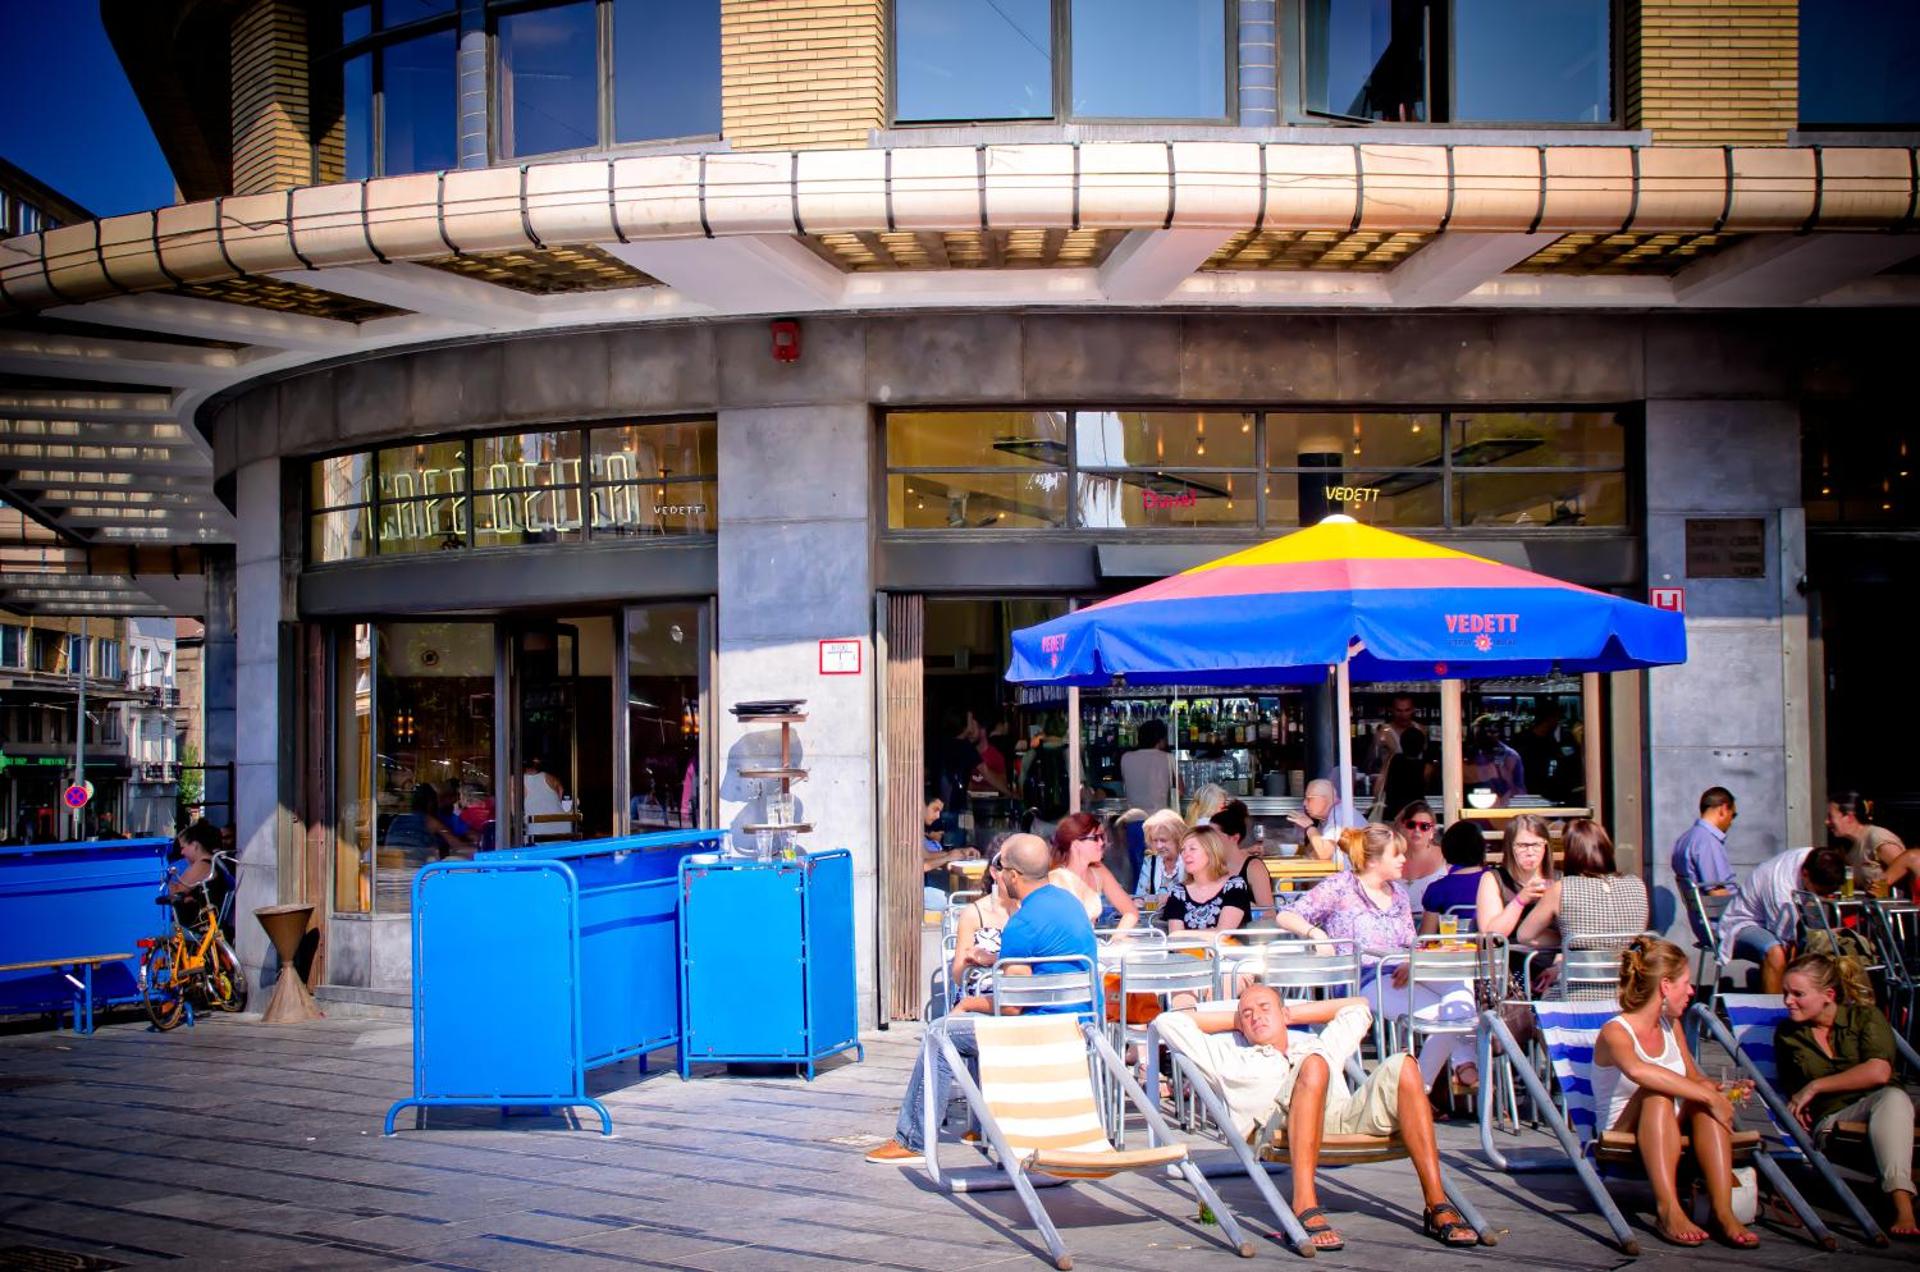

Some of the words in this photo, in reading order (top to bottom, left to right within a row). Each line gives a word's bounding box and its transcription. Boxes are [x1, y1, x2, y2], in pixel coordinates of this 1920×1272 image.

[489, 454, 635, 535] BELGA
[1325, 486, 1381, 503] VEDETT
[653, 505, 702, 516] VEDETT
[1444, 613, 1520, 633] VEDETT
